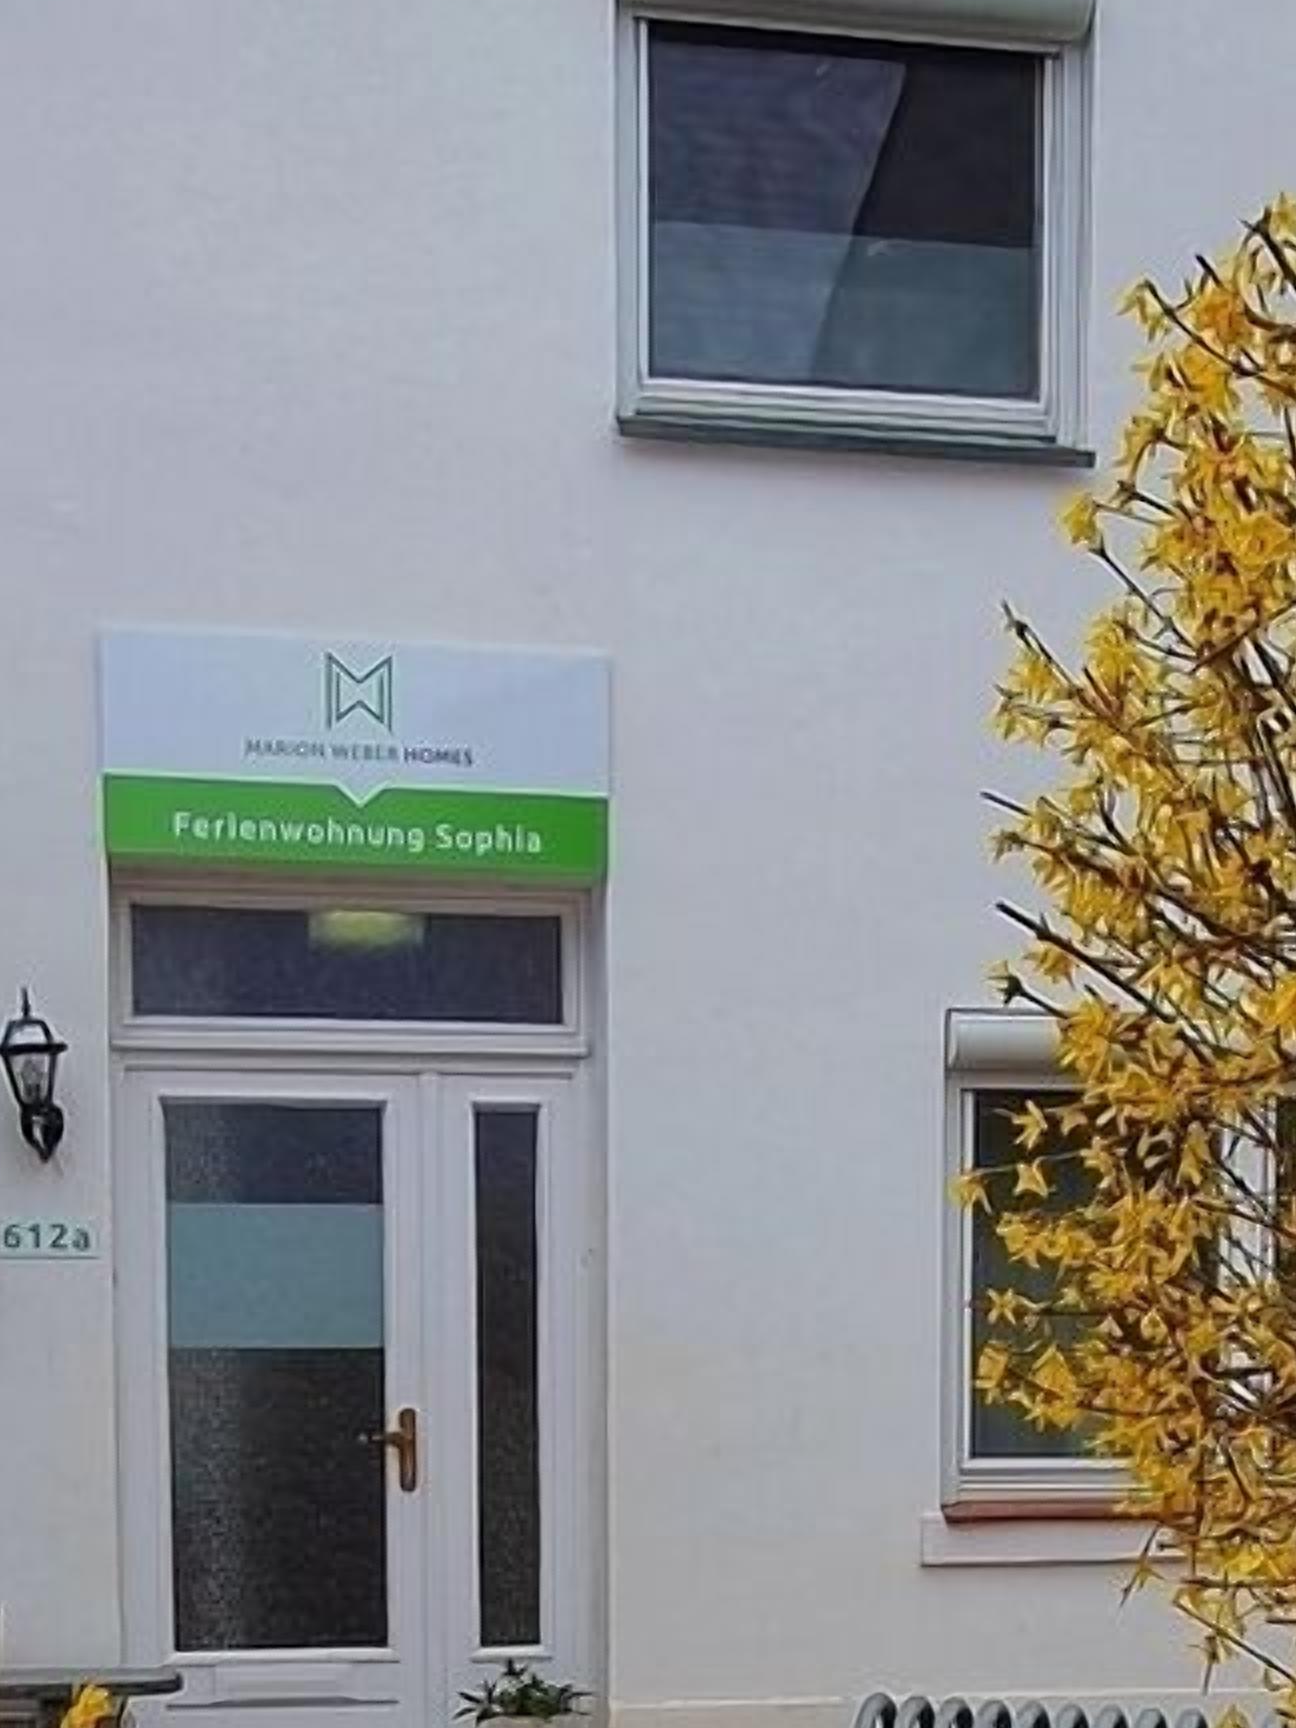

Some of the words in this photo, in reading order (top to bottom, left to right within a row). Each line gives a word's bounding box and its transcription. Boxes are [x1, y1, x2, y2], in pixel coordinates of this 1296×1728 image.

[244, 739, 326, 759] MARION
[332, 743, 401, 763] WEBER
[403, 747, 474, 768] HOMES
[174, 811, 426, 853] Ferienwohnung
[437, 823, 543, 855] Sophia
[3, 1224, 91, 1251] 612a
